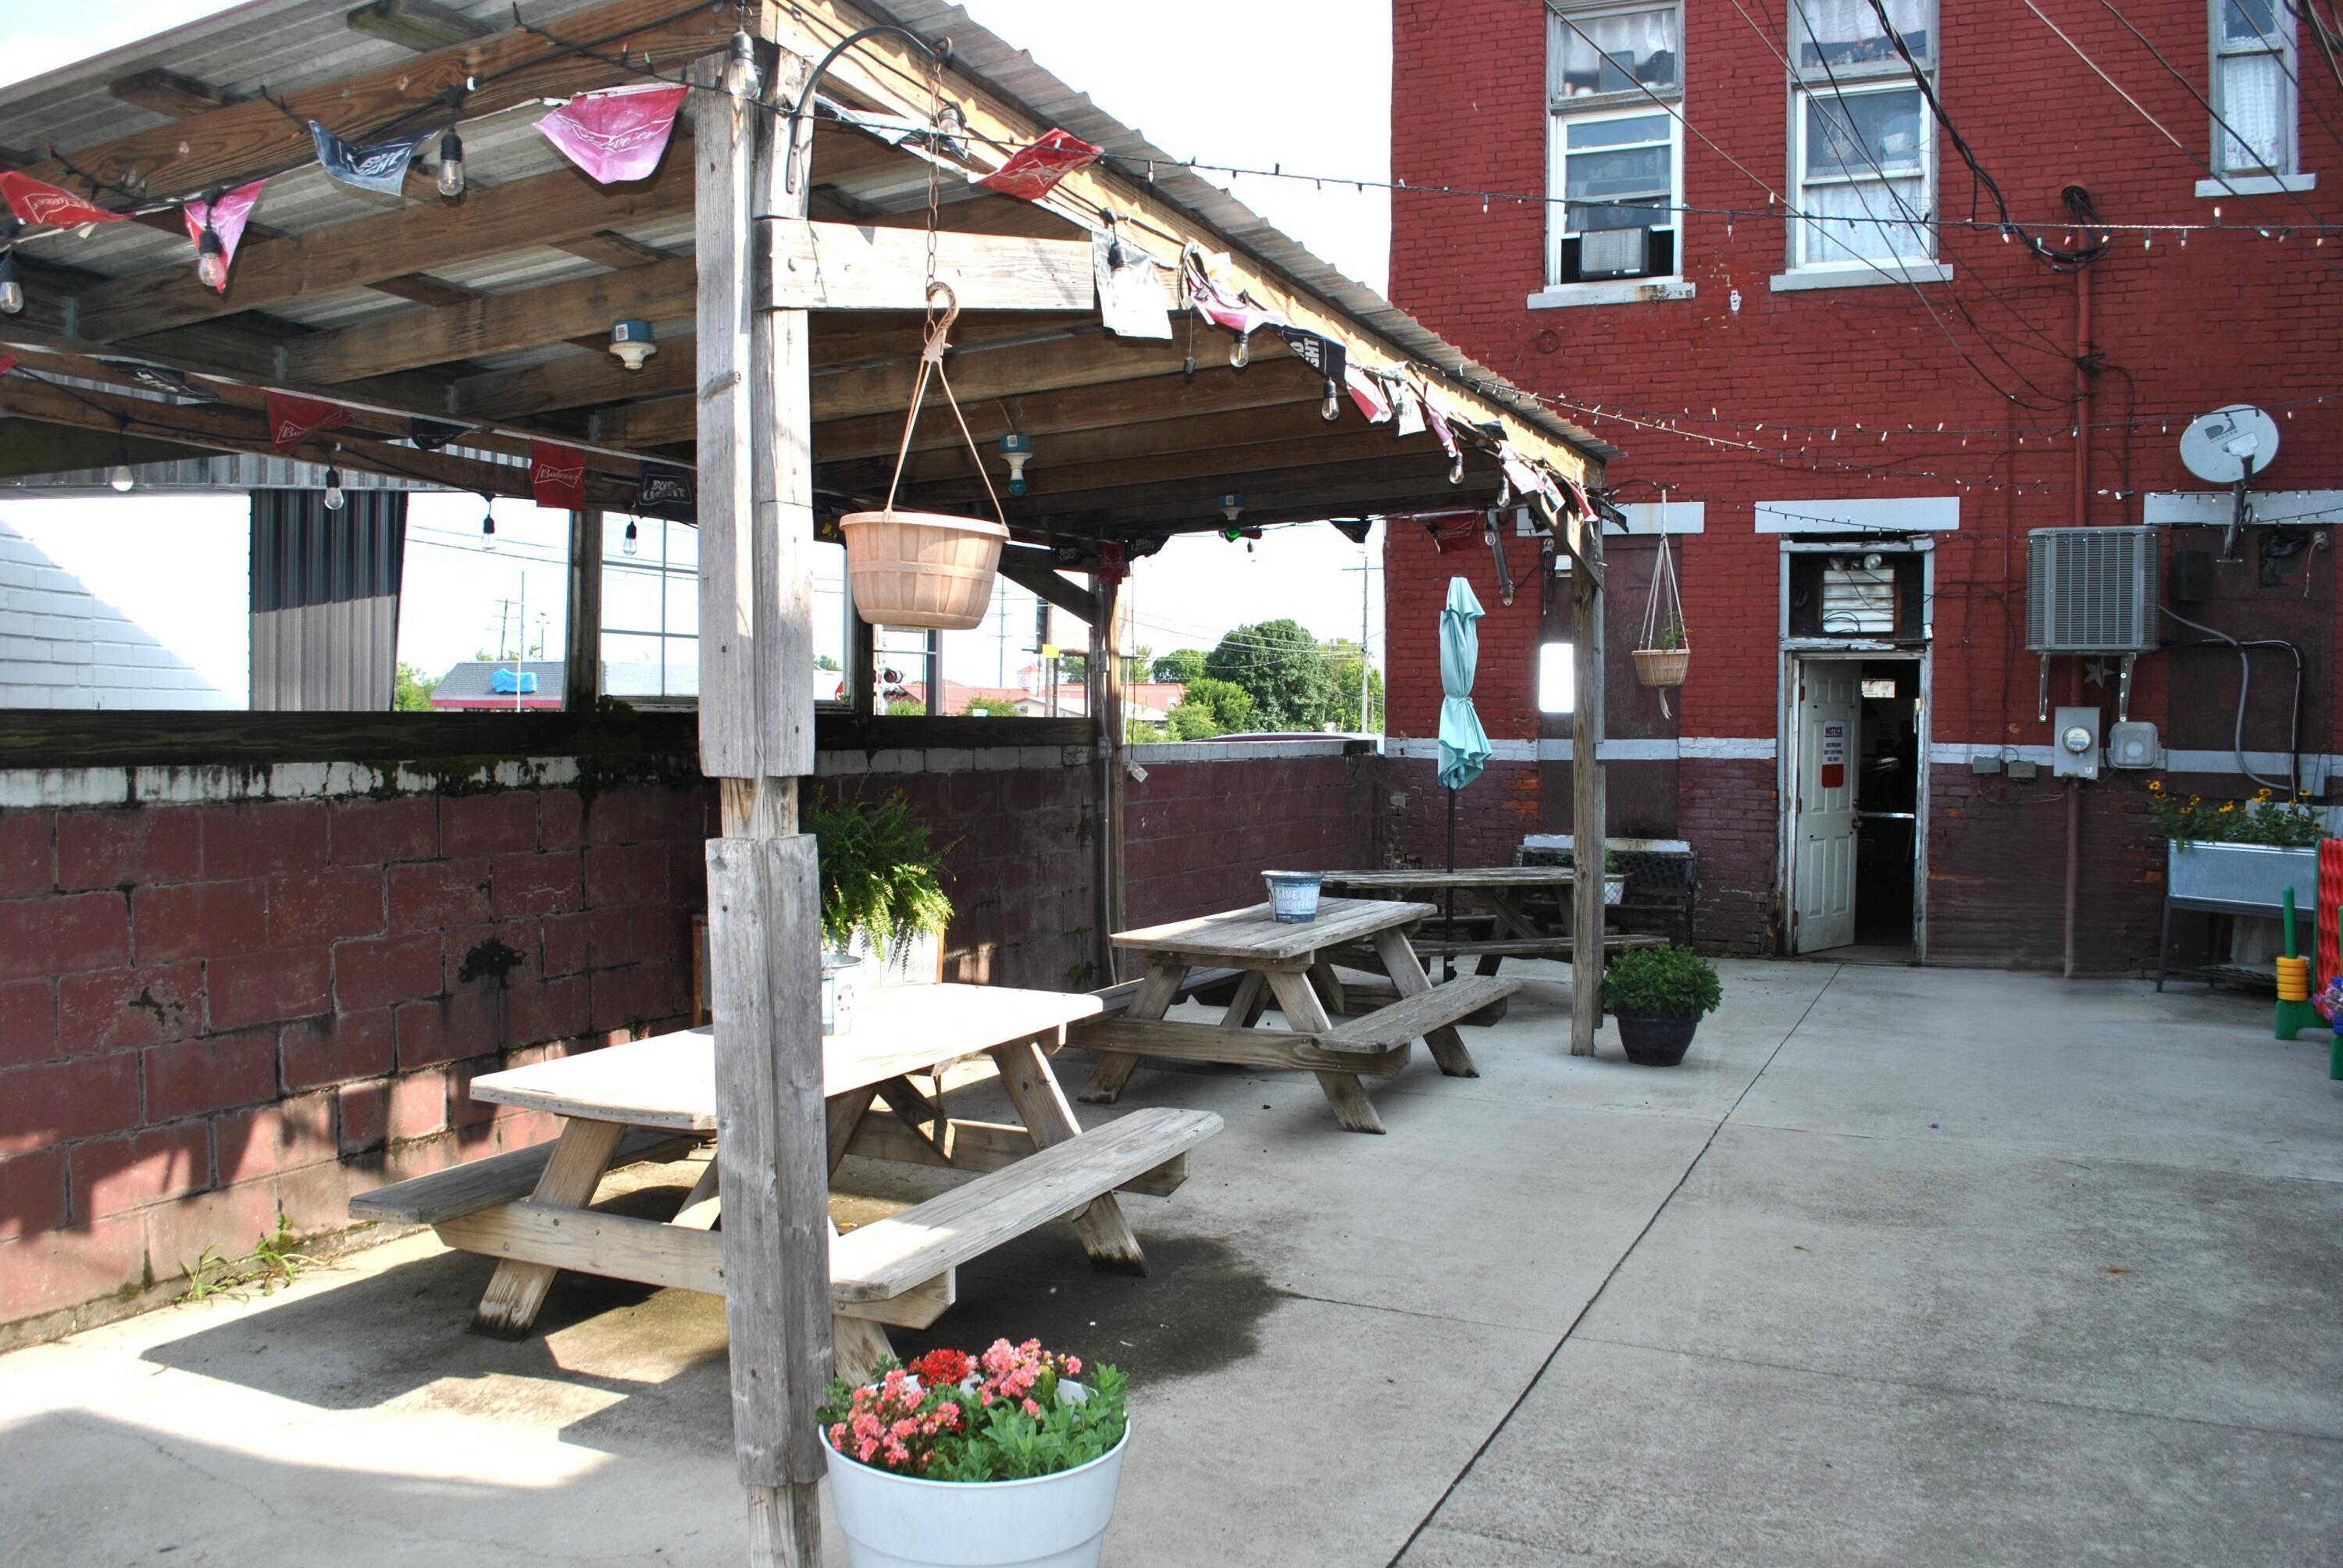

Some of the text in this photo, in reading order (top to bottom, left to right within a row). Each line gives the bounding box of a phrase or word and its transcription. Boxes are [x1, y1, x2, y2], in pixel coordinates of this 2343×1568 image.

[1825, 726, 1843, 736] NOTICE
[1276, 889, 1318, 900] LIVE LIFE
